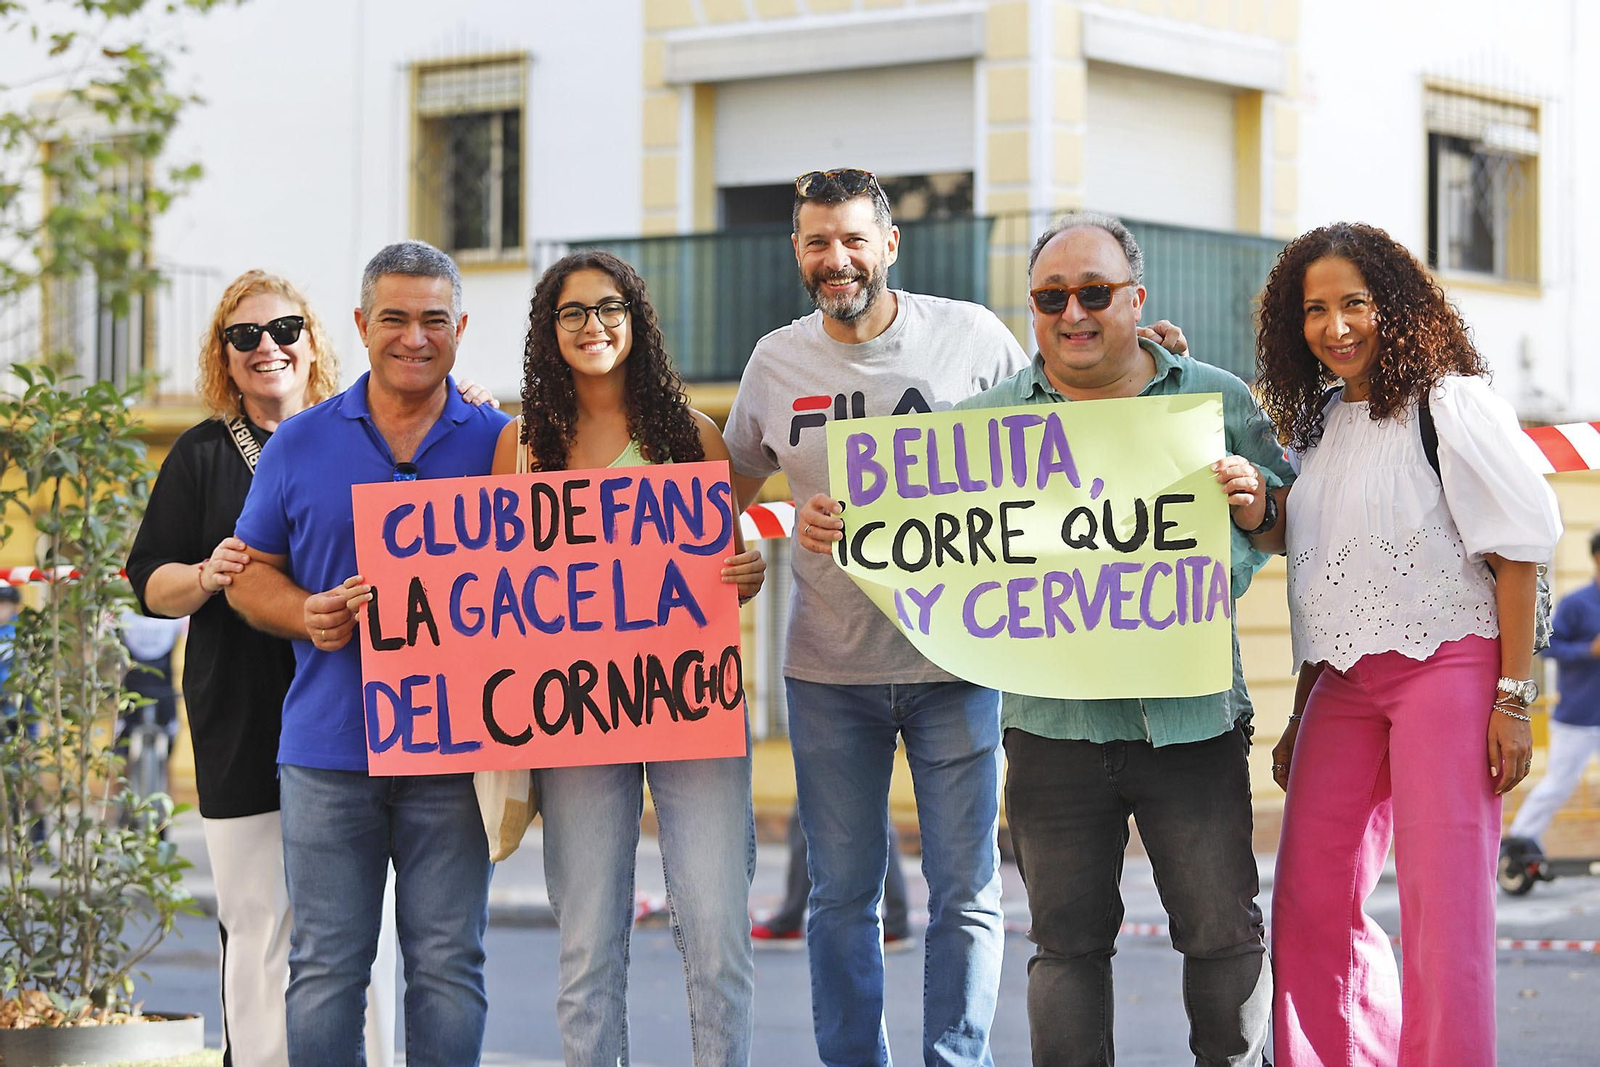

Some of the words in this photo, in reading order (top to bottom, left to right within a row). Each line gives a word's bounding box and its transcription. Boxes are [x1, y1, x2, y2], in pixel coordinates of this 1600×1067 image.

[846, 412, 1105, 507] BELLITA,
[382, 487, 525, 558] CLUB
[531, 479, 596, 552] DE
[600, 476, 733, 556] FANS
[1061, 494, 1197, 553] QUE
[367, 576, 440, 651] LA
[449, 559, 708, 639] GACELA
[962, 555, 1231, 638] CERVECITA
[364, 674, 484, 755] DEL
[482, 646, 742, 747] CORNACHO
